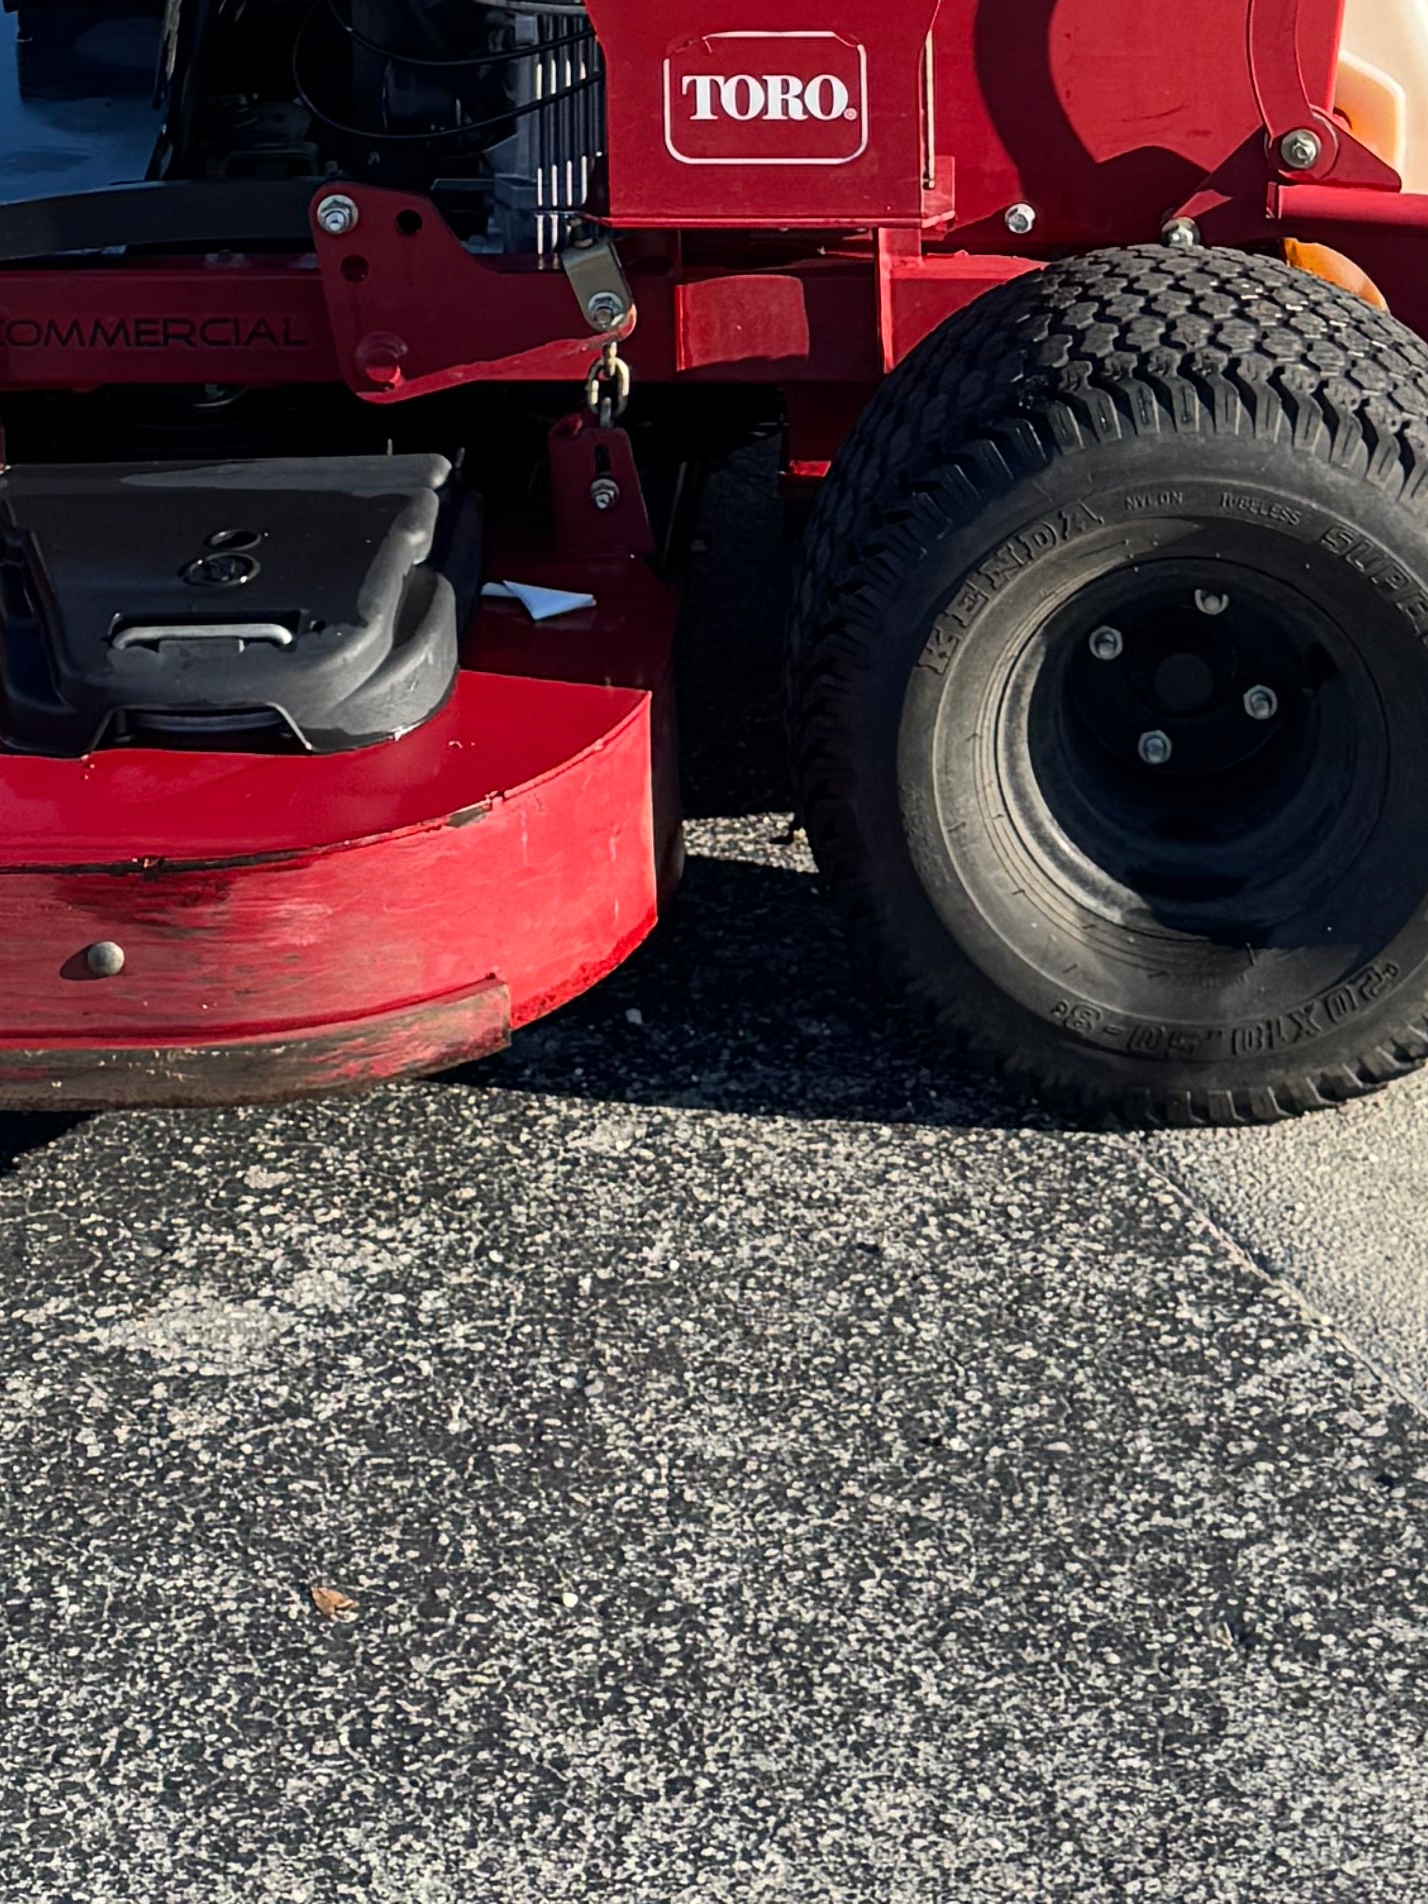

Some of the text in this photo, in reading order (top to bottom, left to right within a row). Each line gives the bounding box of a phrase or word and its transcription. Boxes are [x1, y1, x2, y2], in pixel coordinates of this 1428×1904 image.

[682, 74, 849, 121] TORO
[1125, 491, 1184, 511] NYLON
[1220, 492, 1302, 526] TUBELESS
[917, 498, 1105, 676] KENDA
